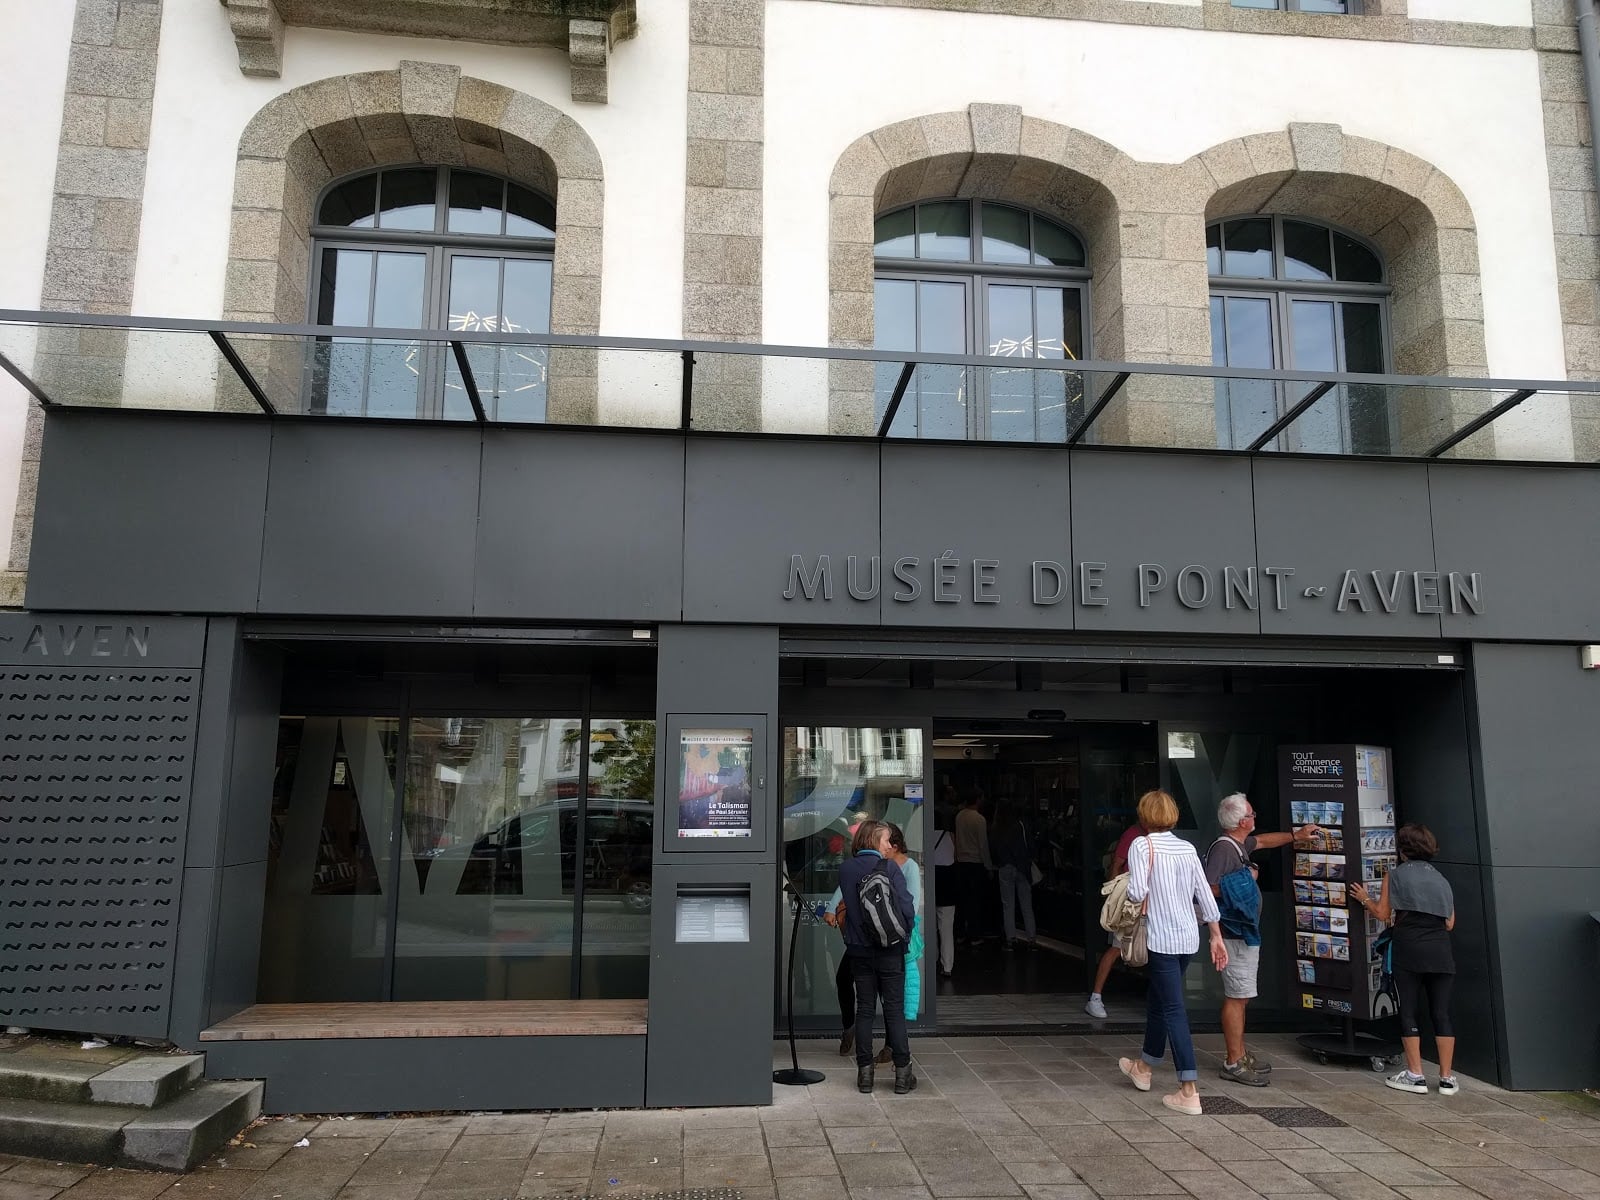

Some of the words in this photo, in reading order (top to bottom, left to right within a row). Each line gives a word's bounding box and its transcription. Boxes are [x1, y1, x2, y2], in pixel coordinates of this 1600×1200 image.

[782, 549, 1001, 603] MUSÉE
[1032, 559, 1109, 606] DE
[1291, 752, 1314, 760] TOUT
[1295, 759, 1341, 767] commence
